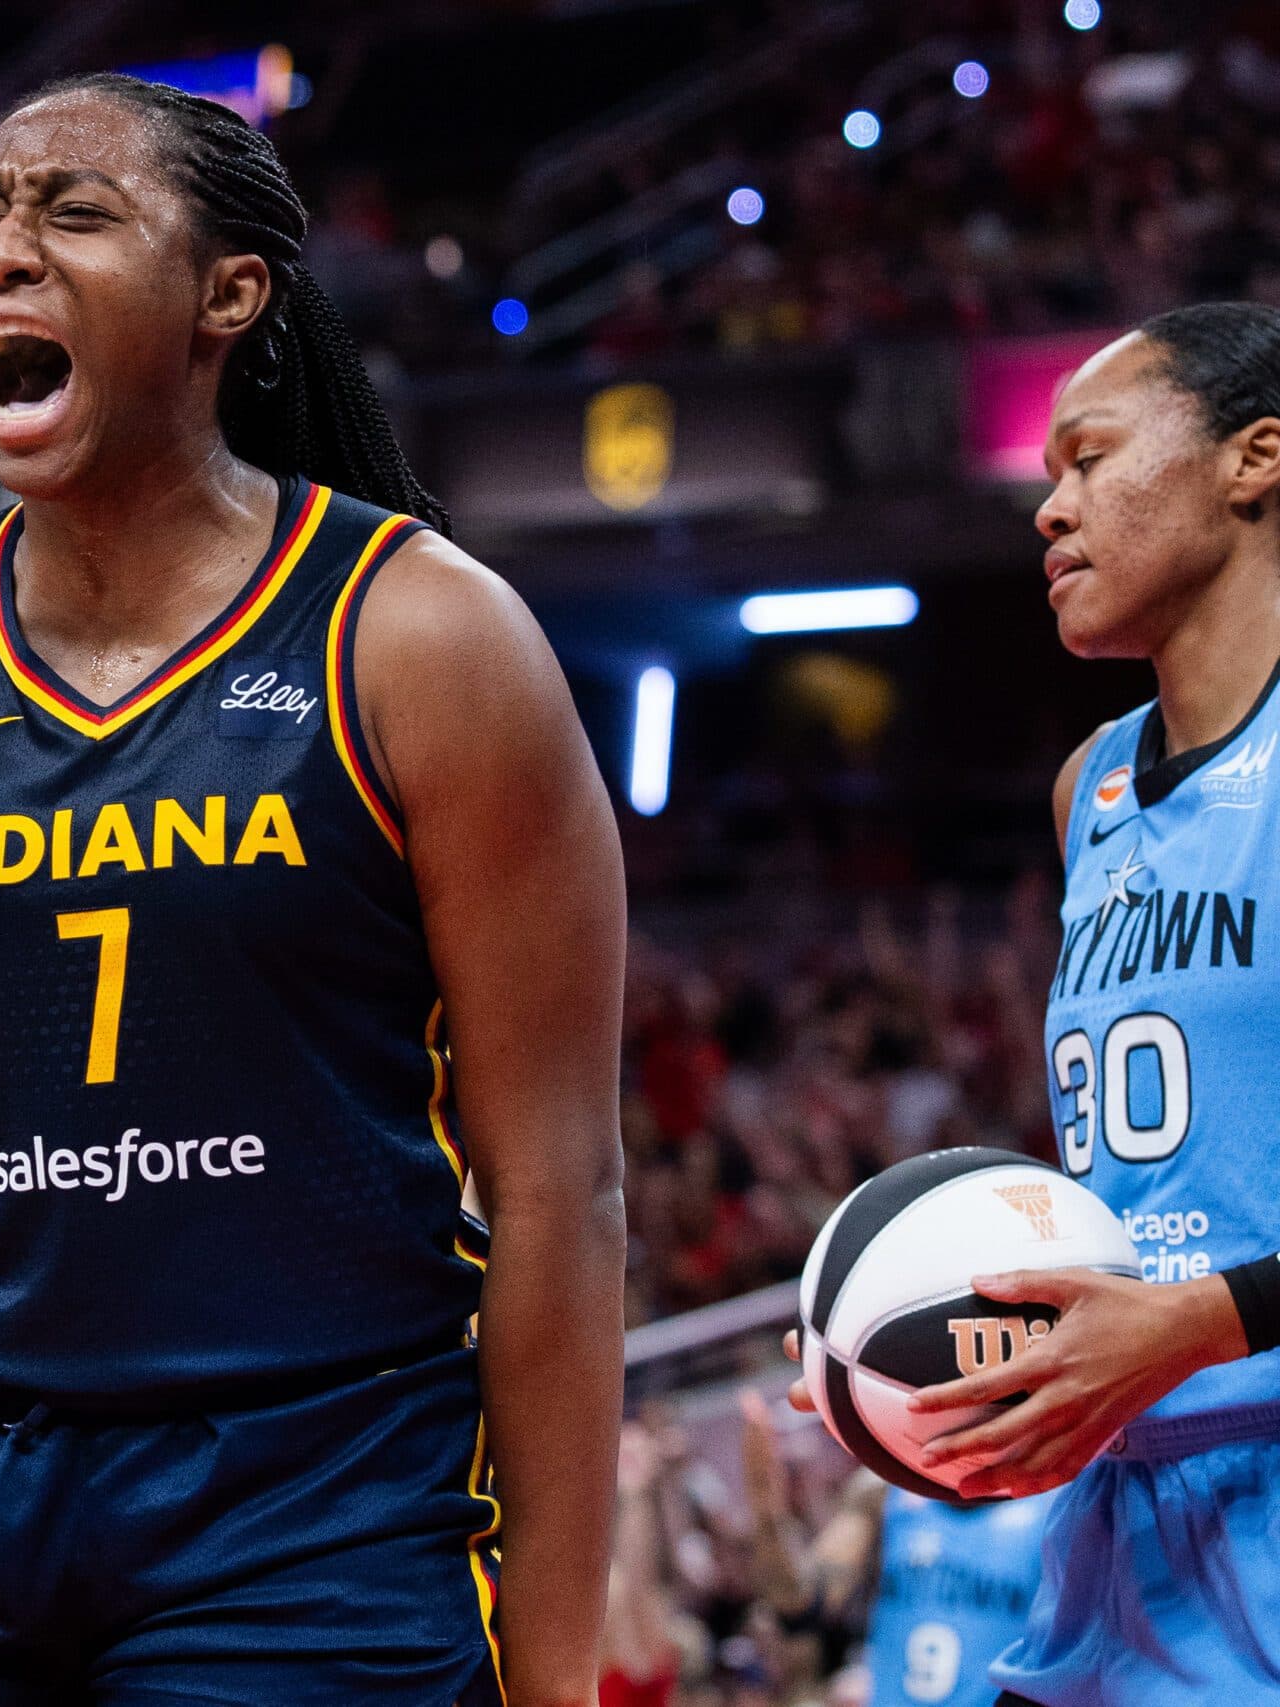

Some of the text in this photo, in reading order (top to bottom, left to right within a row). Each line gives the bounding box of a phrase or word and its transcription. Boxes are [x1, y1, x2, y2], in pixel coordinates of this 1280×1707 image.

[220, 671, 318, 724] Lilly
[56, 907, 130, 1085] 7
[1052, 1011, 1192, 1177] 30
[904, 1621, 960, 1701] 9
